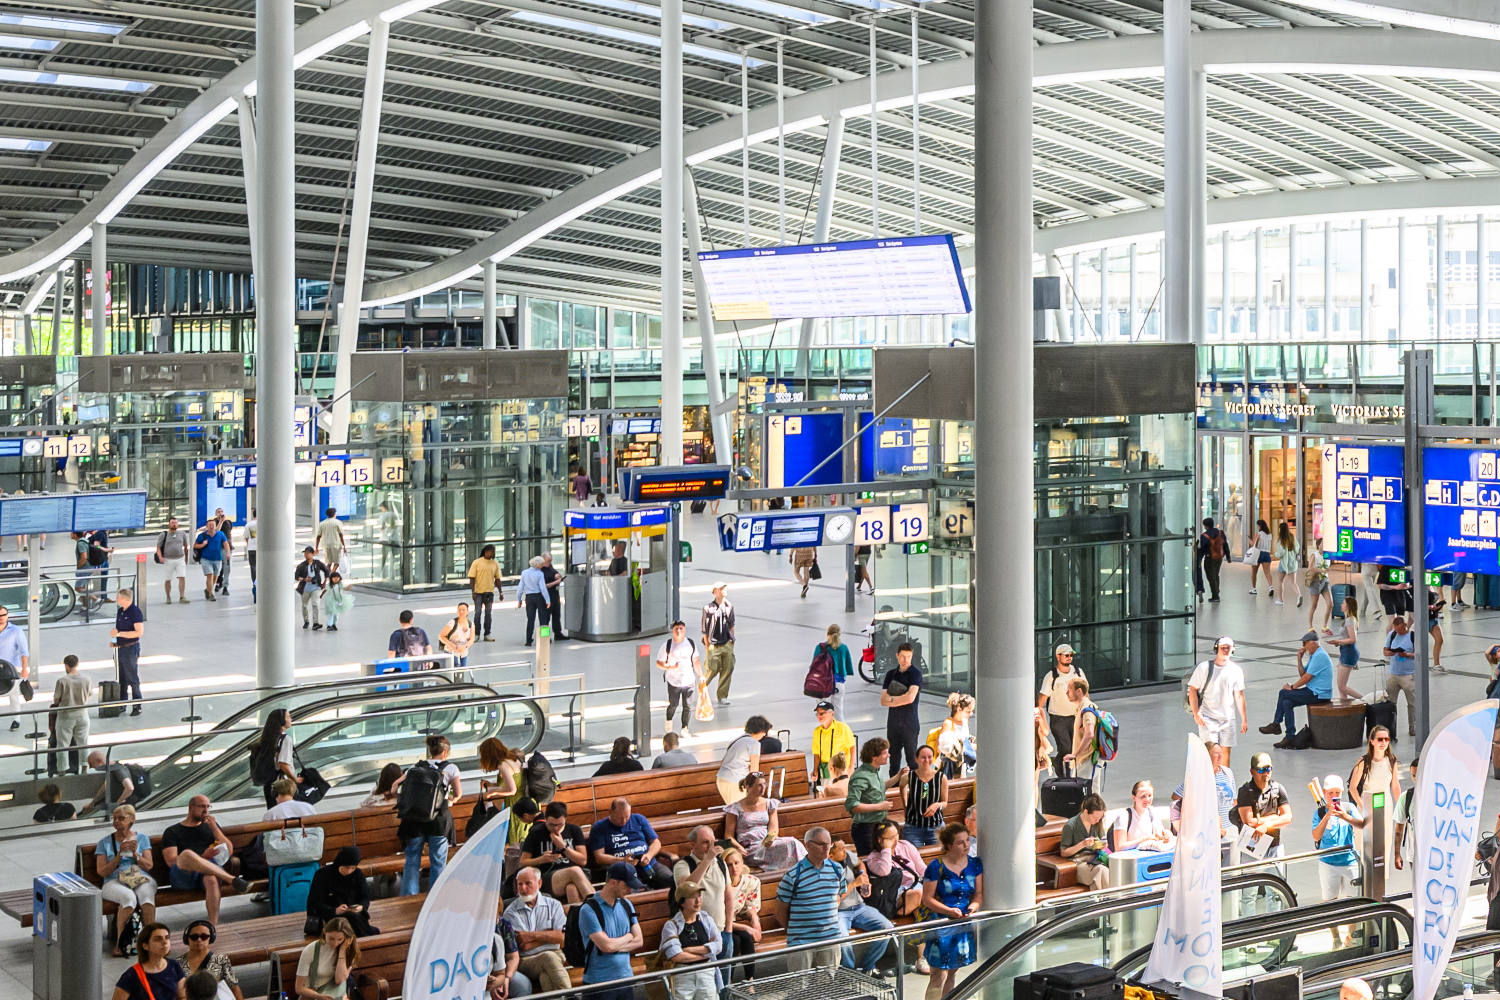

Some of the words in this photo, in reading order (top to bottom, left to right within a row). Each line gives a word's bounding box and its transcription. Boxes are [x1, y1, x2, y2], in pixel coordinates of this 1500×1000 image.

[1279, 403, 1316, 416] SECRET
[49, 445, 61, 456] 11
[72, 443, 87, 454] 12
[1340, 457, 1360, 470] 1-19
[1481, 462, 1494, 476] 20
[321, 470, 341, 484] 14
[351, 468, 368, 482] 15
[1354, 483, 1363, 498] A
[1386, 485, 1394, 500] B
[1442, 488, 1452, 504] H
[860, 520, 884, 541] 18
[900, 516, 923, 537] 19
[1353, 529, 1381, 541] Centrum
[1447, 536, 1498, 551] Jaarbeursplein
[1434, 782, 1477, 818] DAG
[429, 944, 489, 995] DAG
